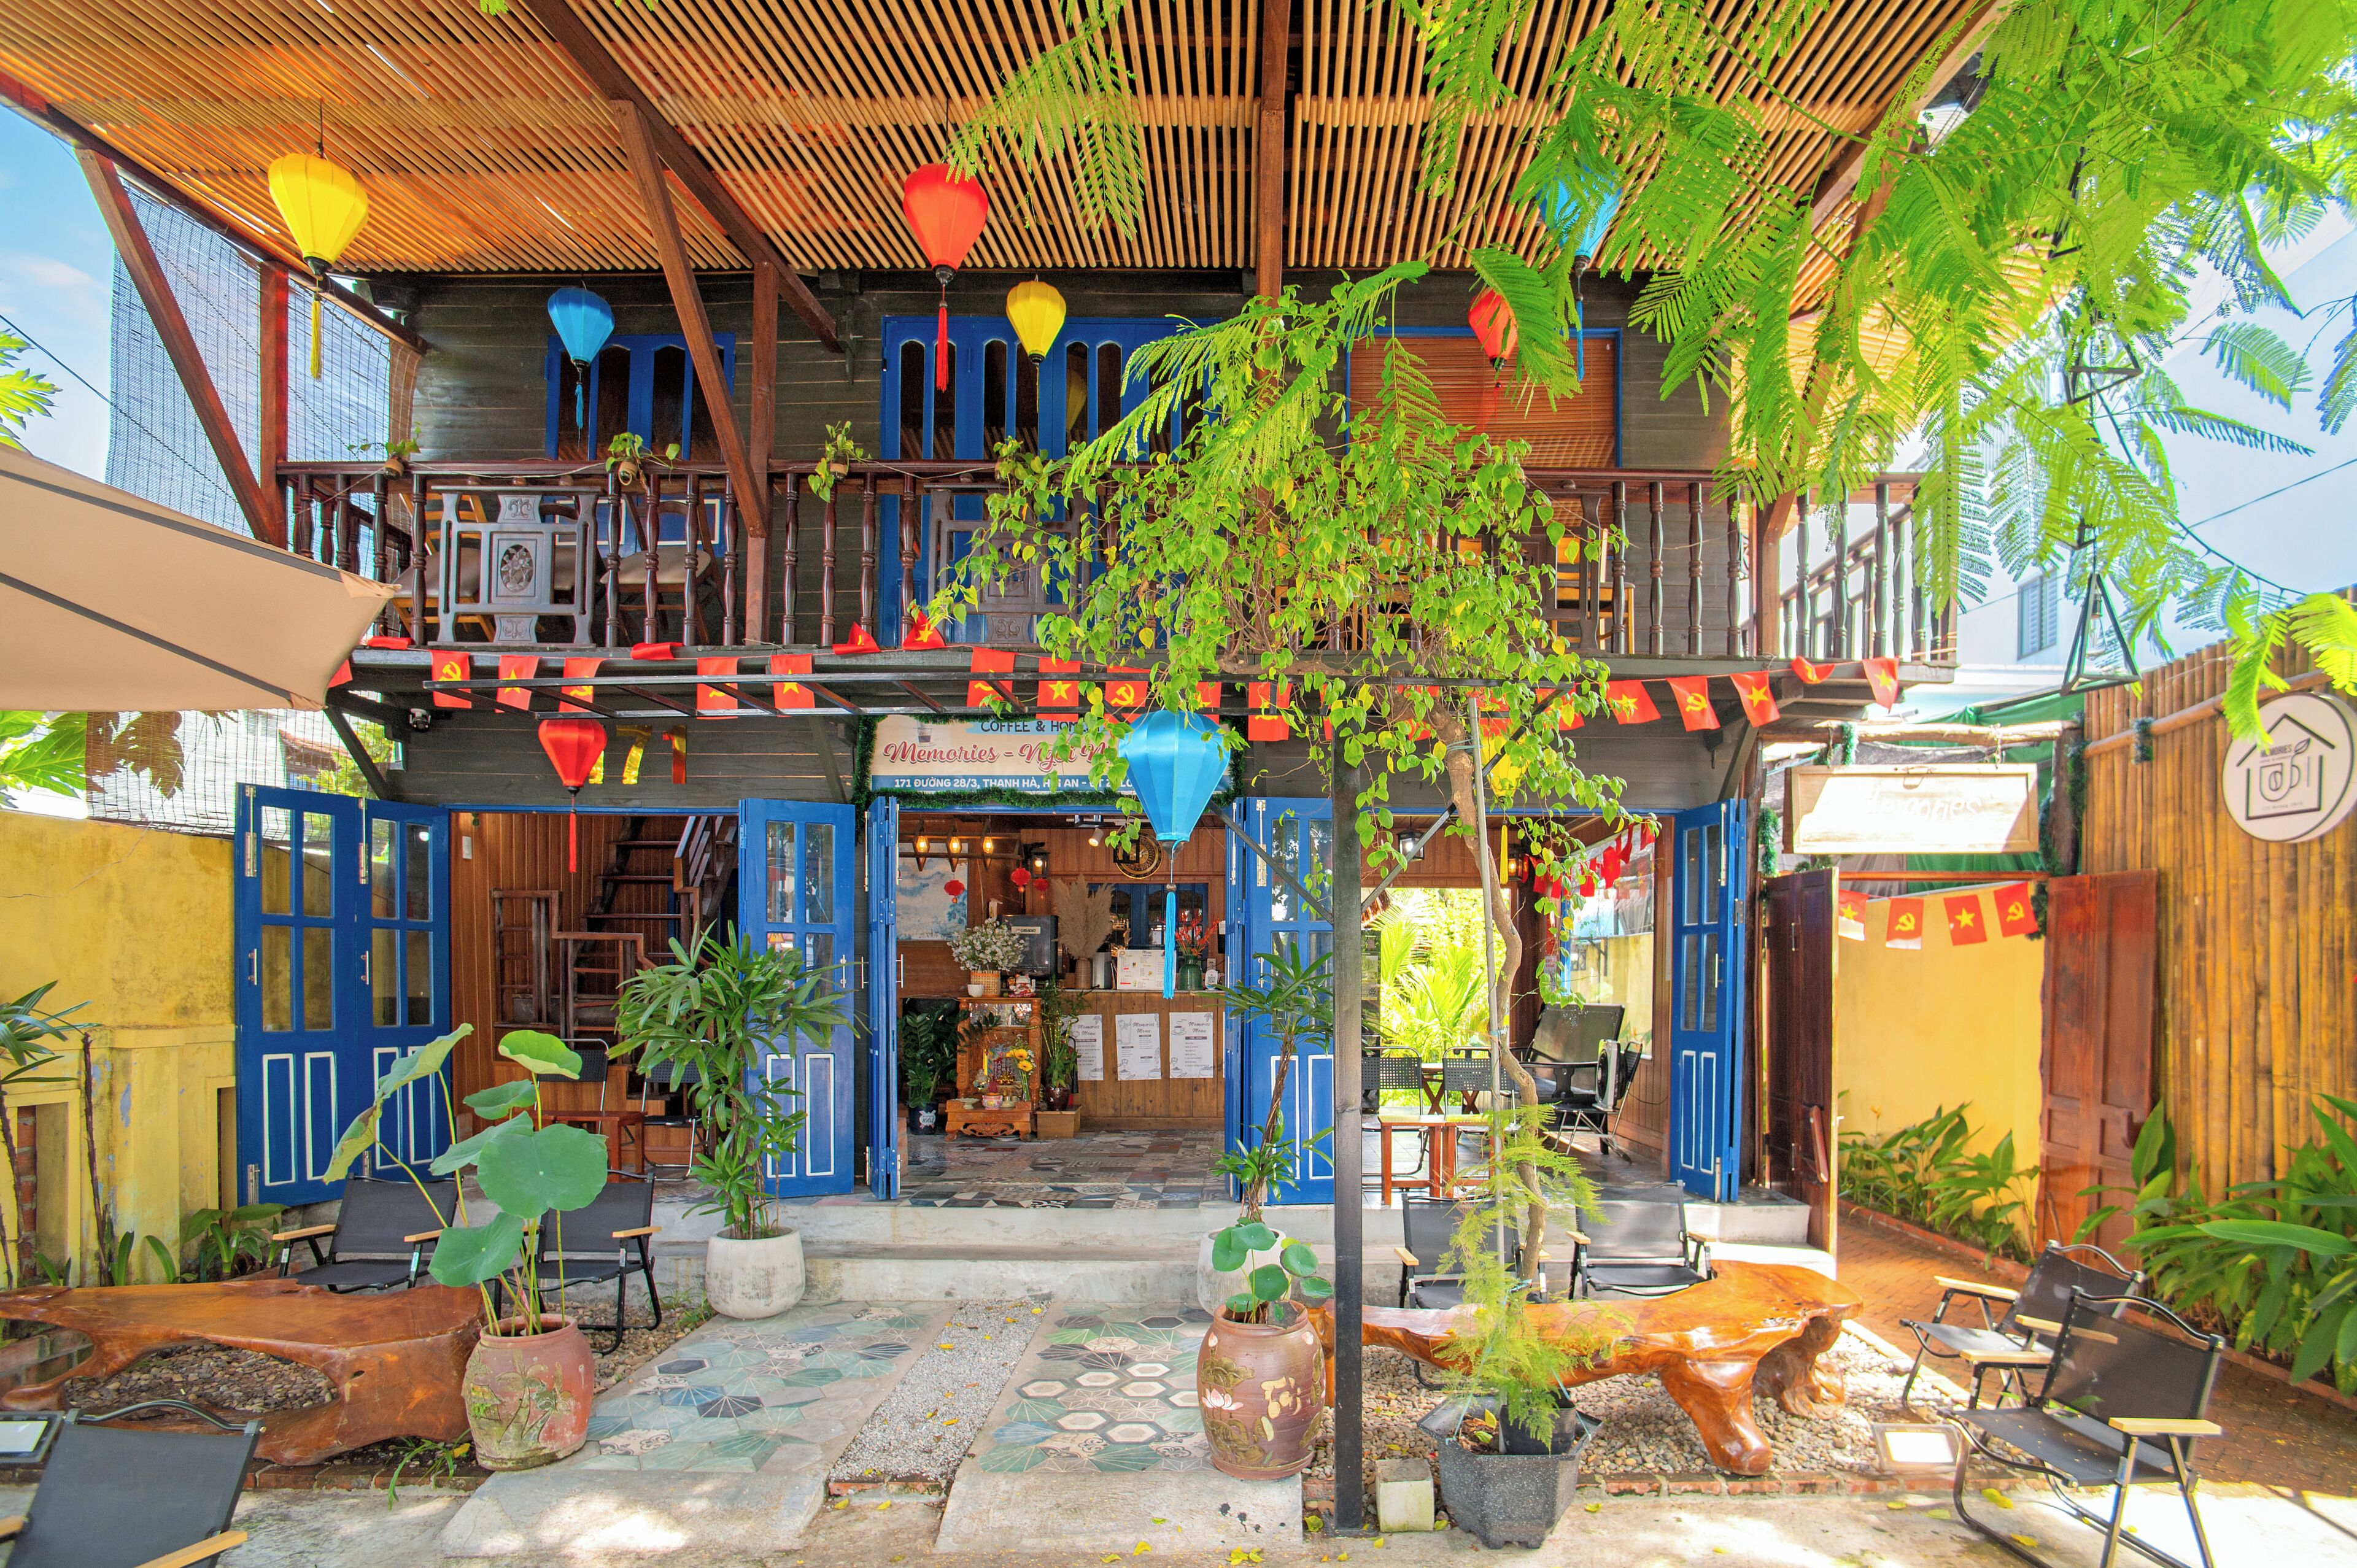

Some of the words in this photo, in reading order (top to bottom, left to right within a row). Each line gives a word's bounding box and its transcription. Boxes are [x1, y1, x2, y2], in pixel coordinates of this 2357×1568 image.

[981, 720, 1030, 732] COFFEE
[1035, 720, 1045, 732] &
[883, 741, 999, 763] Memories
[894, 779, 911, 787] 171
[913, 776, 951, 788] ĐƯỜNG
[953, 778, 980, 789] 28/3,
[983, 779, 1020, 787] THANH
[1022, 776, 1040, 789] HÀ,
[1043, 779, 1061, 787] HI
[1064, 779, 1078, 787] AN
[1869, 786, 1983, 822] emories
